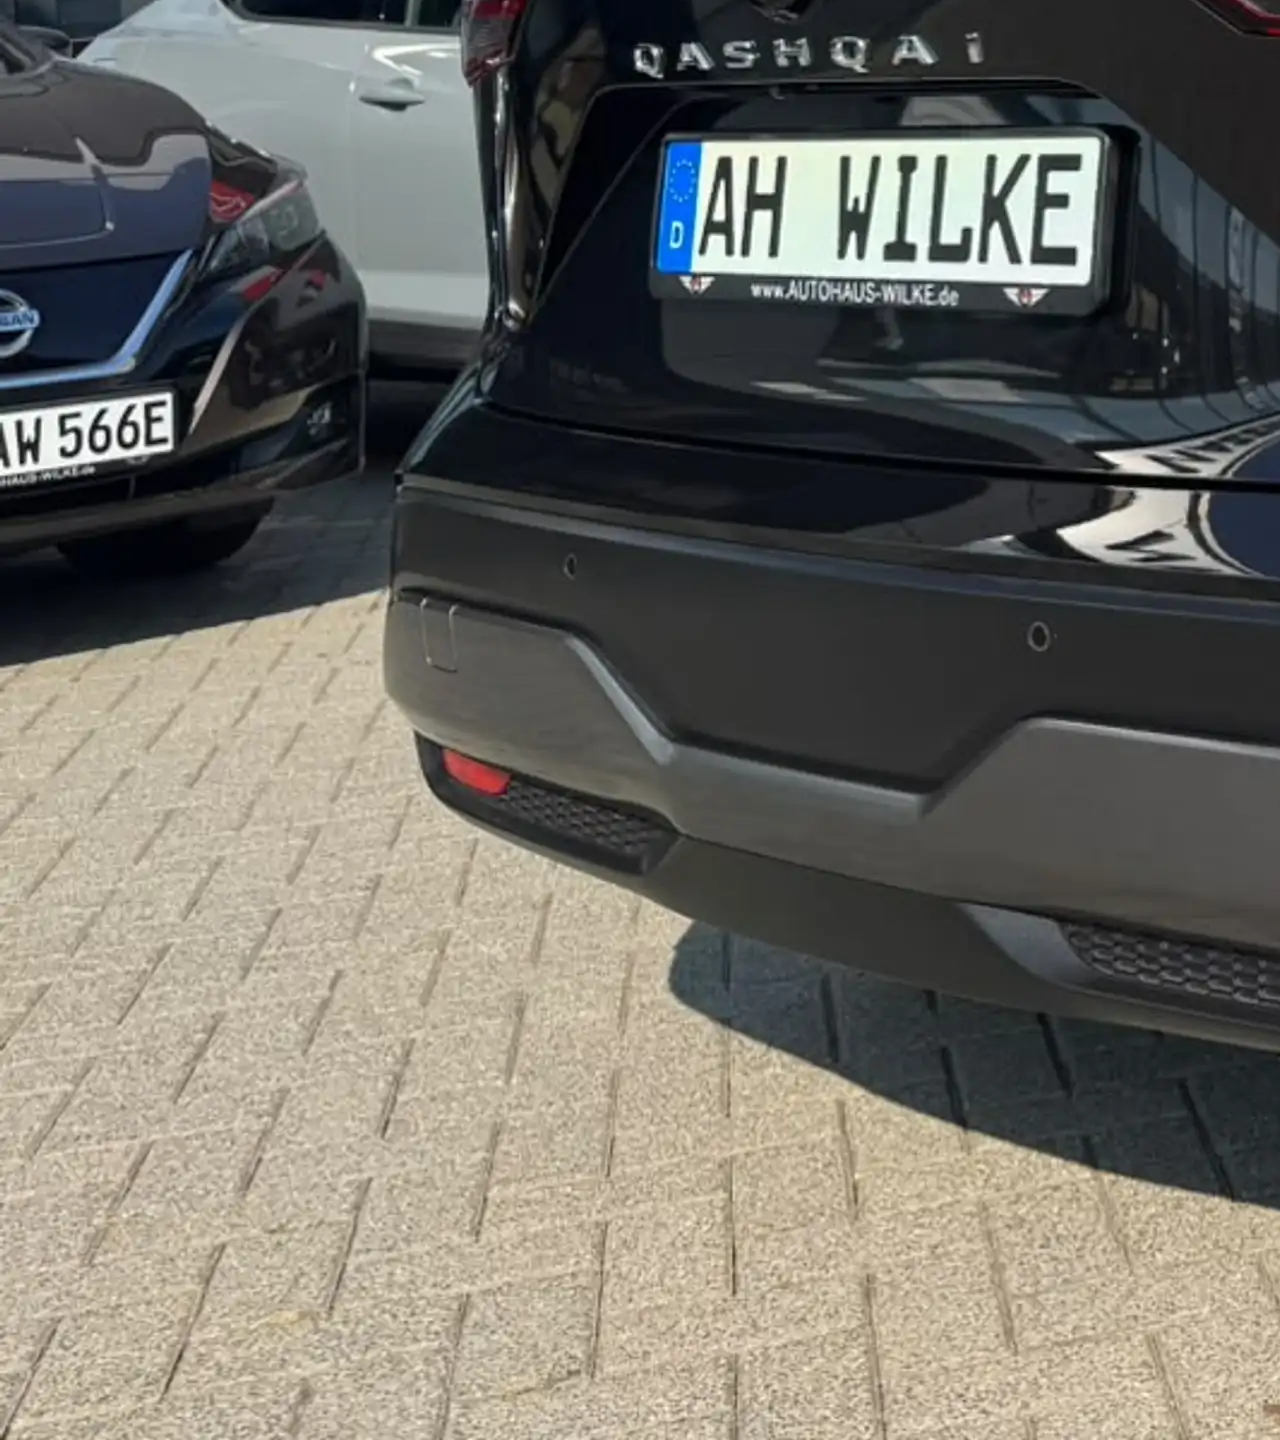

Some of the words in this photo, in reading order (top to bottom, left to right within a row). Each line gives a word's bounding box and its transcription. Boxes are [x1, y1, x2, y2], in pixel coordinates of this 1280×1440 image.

[698, 156, 788, 258] AH
[837, 153, 1083, 267] WILKE
[669, 220, 685, 249] D
[750, 278, 960, 308] www.AUTOHAUS-WILKE.de
[58, 399, 170, 461] 566E
